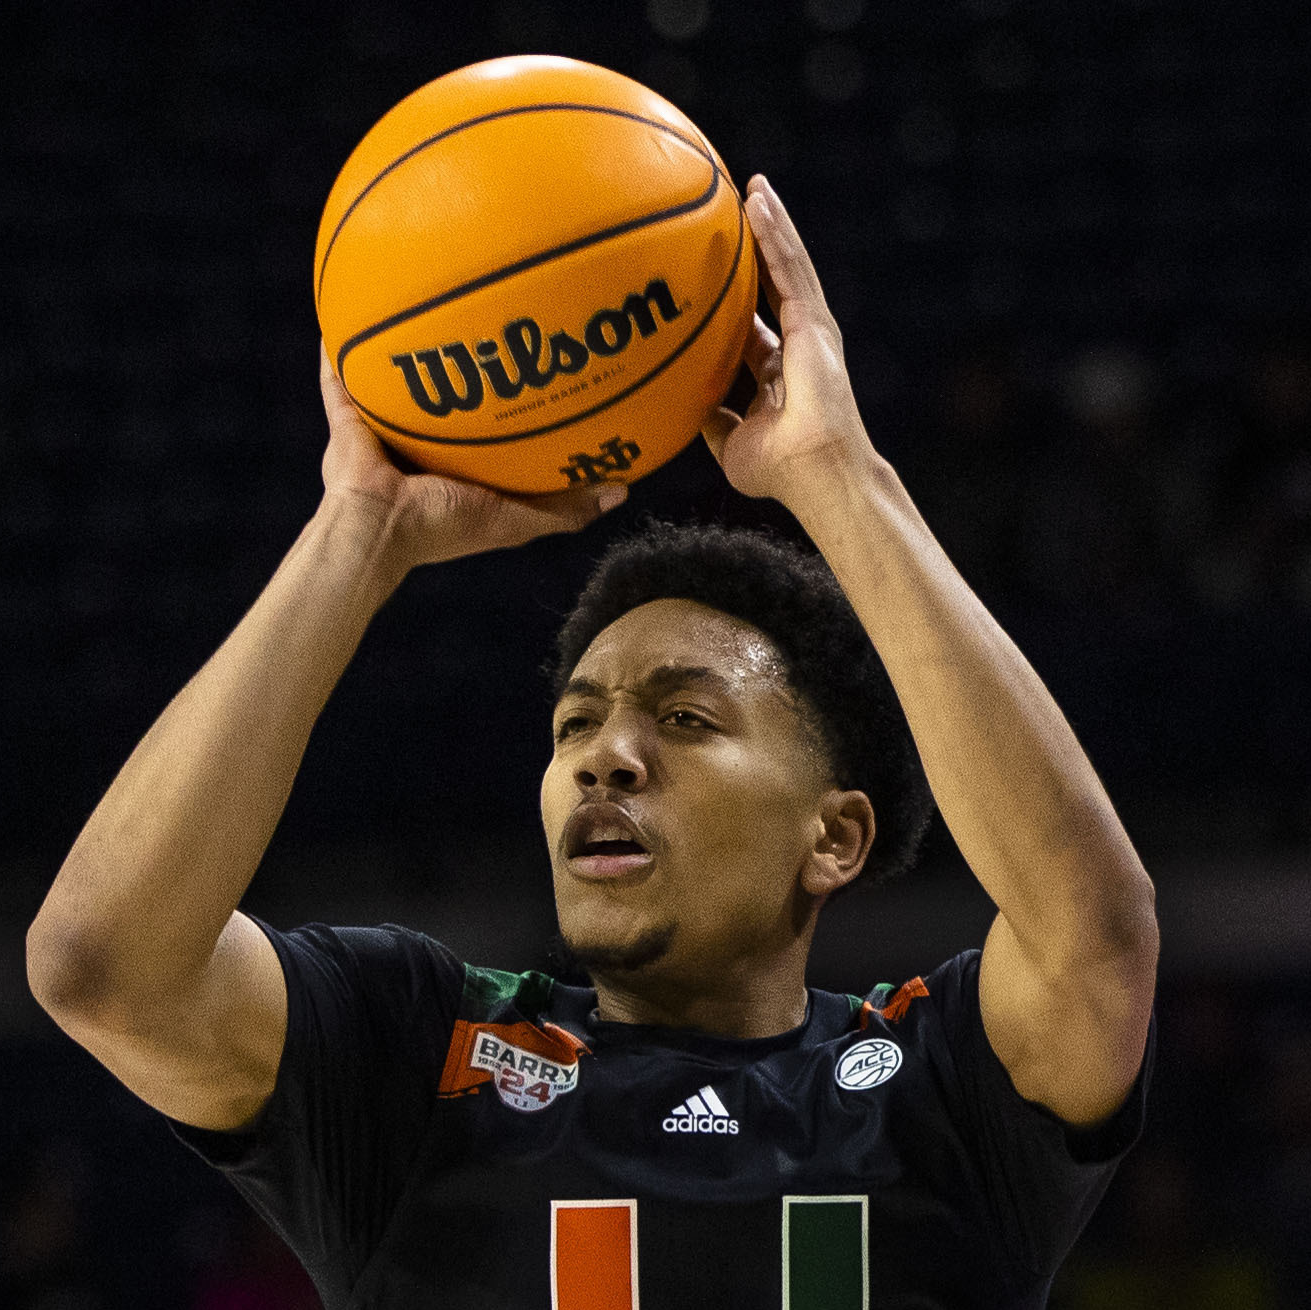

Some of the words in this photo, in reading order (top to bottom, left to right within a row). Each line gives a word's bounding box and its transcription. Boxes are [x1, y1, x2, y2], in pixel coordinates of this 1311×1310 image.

[391, 277, 682, 417] Wilson
[479, 1038, 576, 1082] BARRY
[845, 1047, 894, 1076] ACC
[499, 1068, 550, 1102] 24
[662, 1114, 739, 1135] adidas
